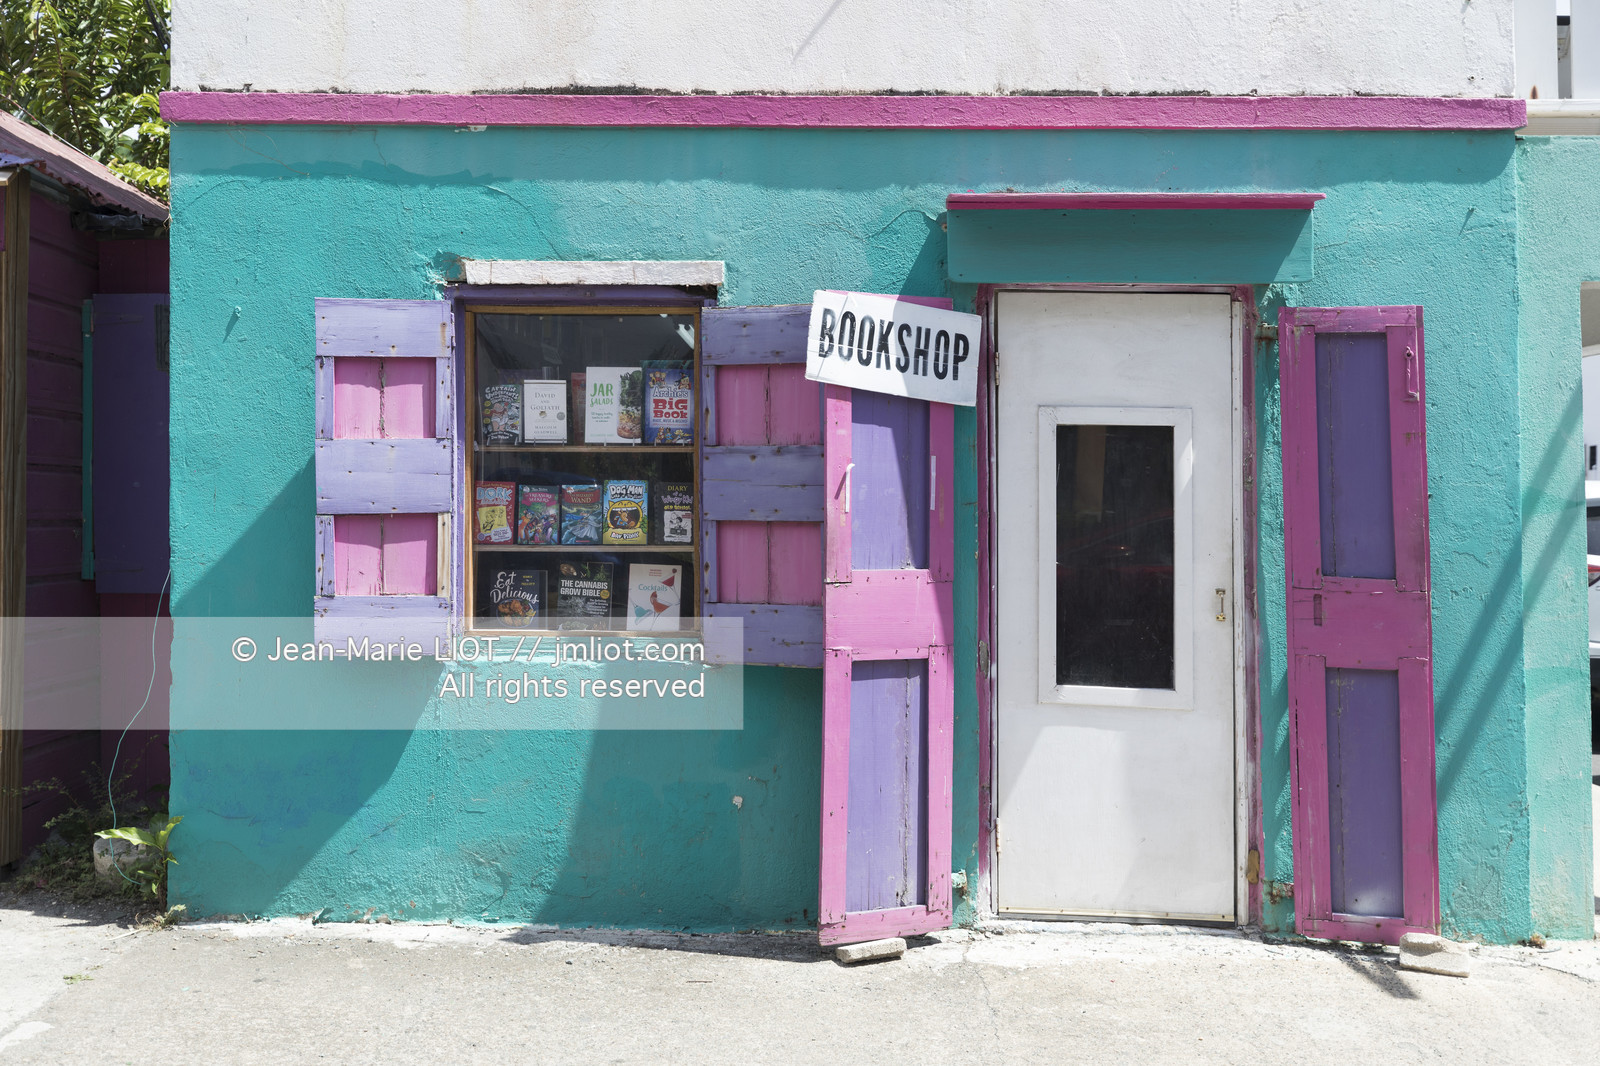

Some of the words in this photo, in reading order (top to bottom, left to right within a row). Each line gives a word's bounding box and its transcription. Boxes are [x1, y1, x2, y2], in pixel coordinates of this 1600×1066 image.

[818, 307, 970, 381] BOOKSHOP
[590, 383, 614, 397] JAR
[653, 386, 689, 398] Archie's
[590, 398, 614, 408] SALADS
[476, 487, 513, 501] DORK
[609, 485, 626, 495] DOG
[494, 571, 517, 589] Eat
[560, 580, 574, 588] THE
[574, 580, 609, 590] CANNABIS
[560, 587, 582, 596] GROW
[583, 588, 601, 597] BIBLE
[638, 583, 669, 592] Cocktails
[489, 585, 540, 604] Delicious
